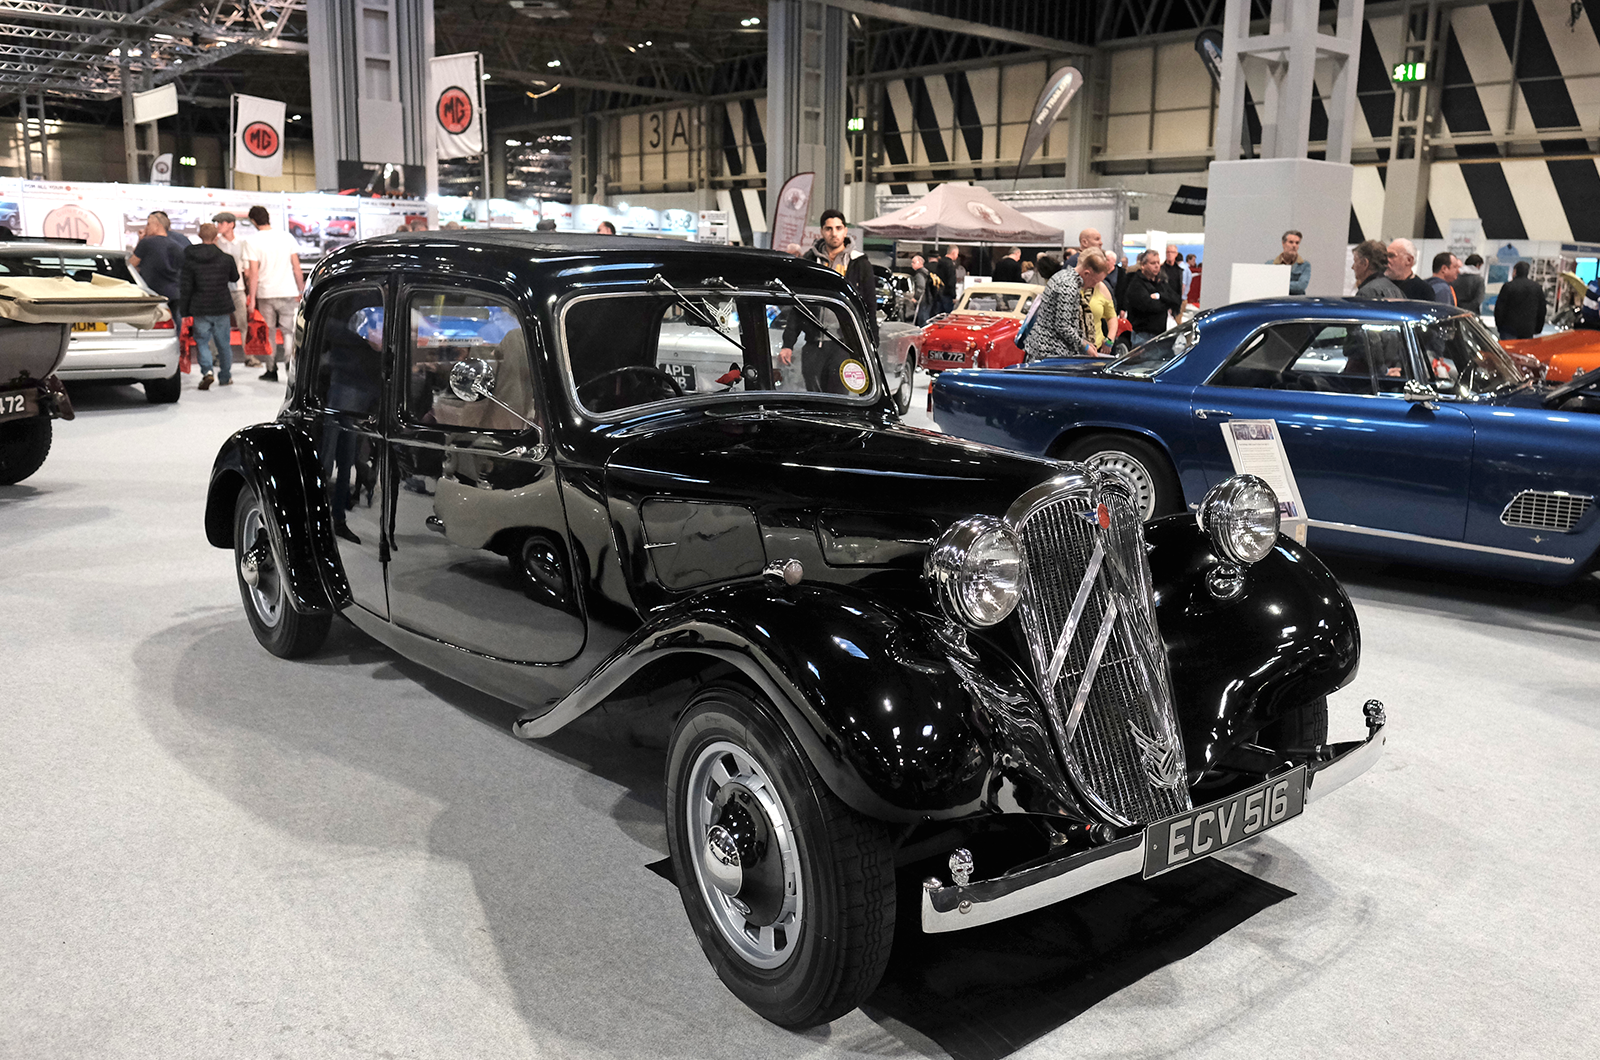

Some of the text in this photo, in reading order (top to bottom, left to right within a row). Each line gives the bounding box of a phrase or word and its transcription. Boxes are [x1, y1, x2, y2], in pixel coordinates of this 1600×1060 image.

[444, 97, 465, 123] MG
[1036, 108, 1049, 124] PRO
[250, 129, 271, 150] MG
[56, 217, 90, 240] MG
[948, 352, 963, 362] 772
[665, 364, 690, 376] APL
[1167, 780, 1289, 865] ECV 516
